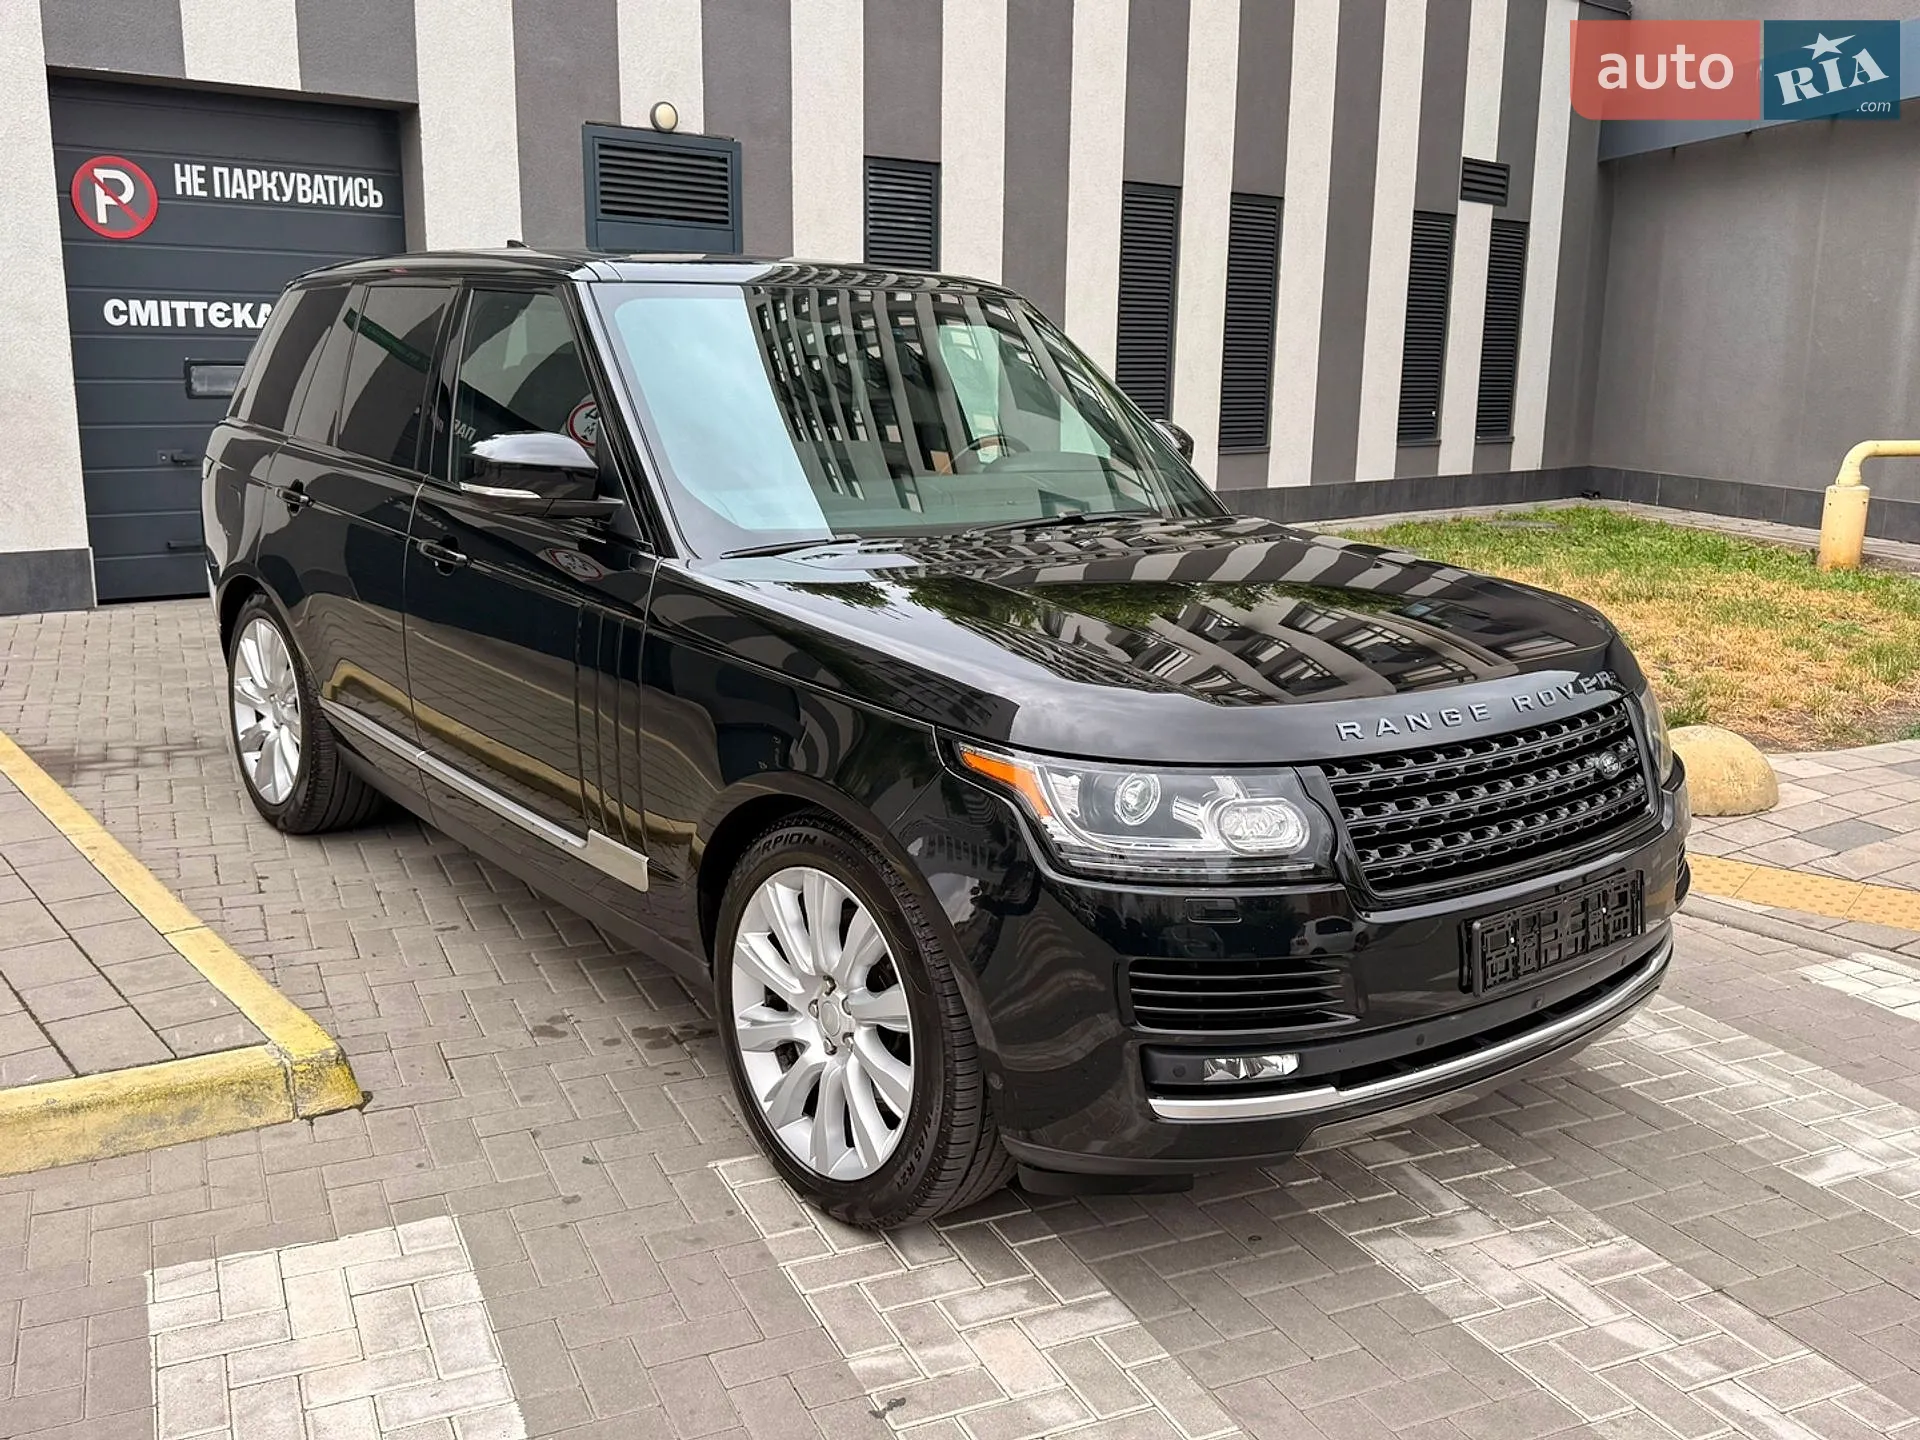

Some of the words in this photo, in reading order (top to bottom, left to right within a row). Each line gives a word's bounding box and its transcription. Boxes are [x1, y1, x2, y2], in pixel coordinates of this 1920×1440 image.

[173, 163, 207, 197] НЕ
[212, 166, 383, 209] ПАРКУВАТИСЬ
[1336, 703, 1491, 742] RANGE
[1512, 670, 1618, 713] ROVER
